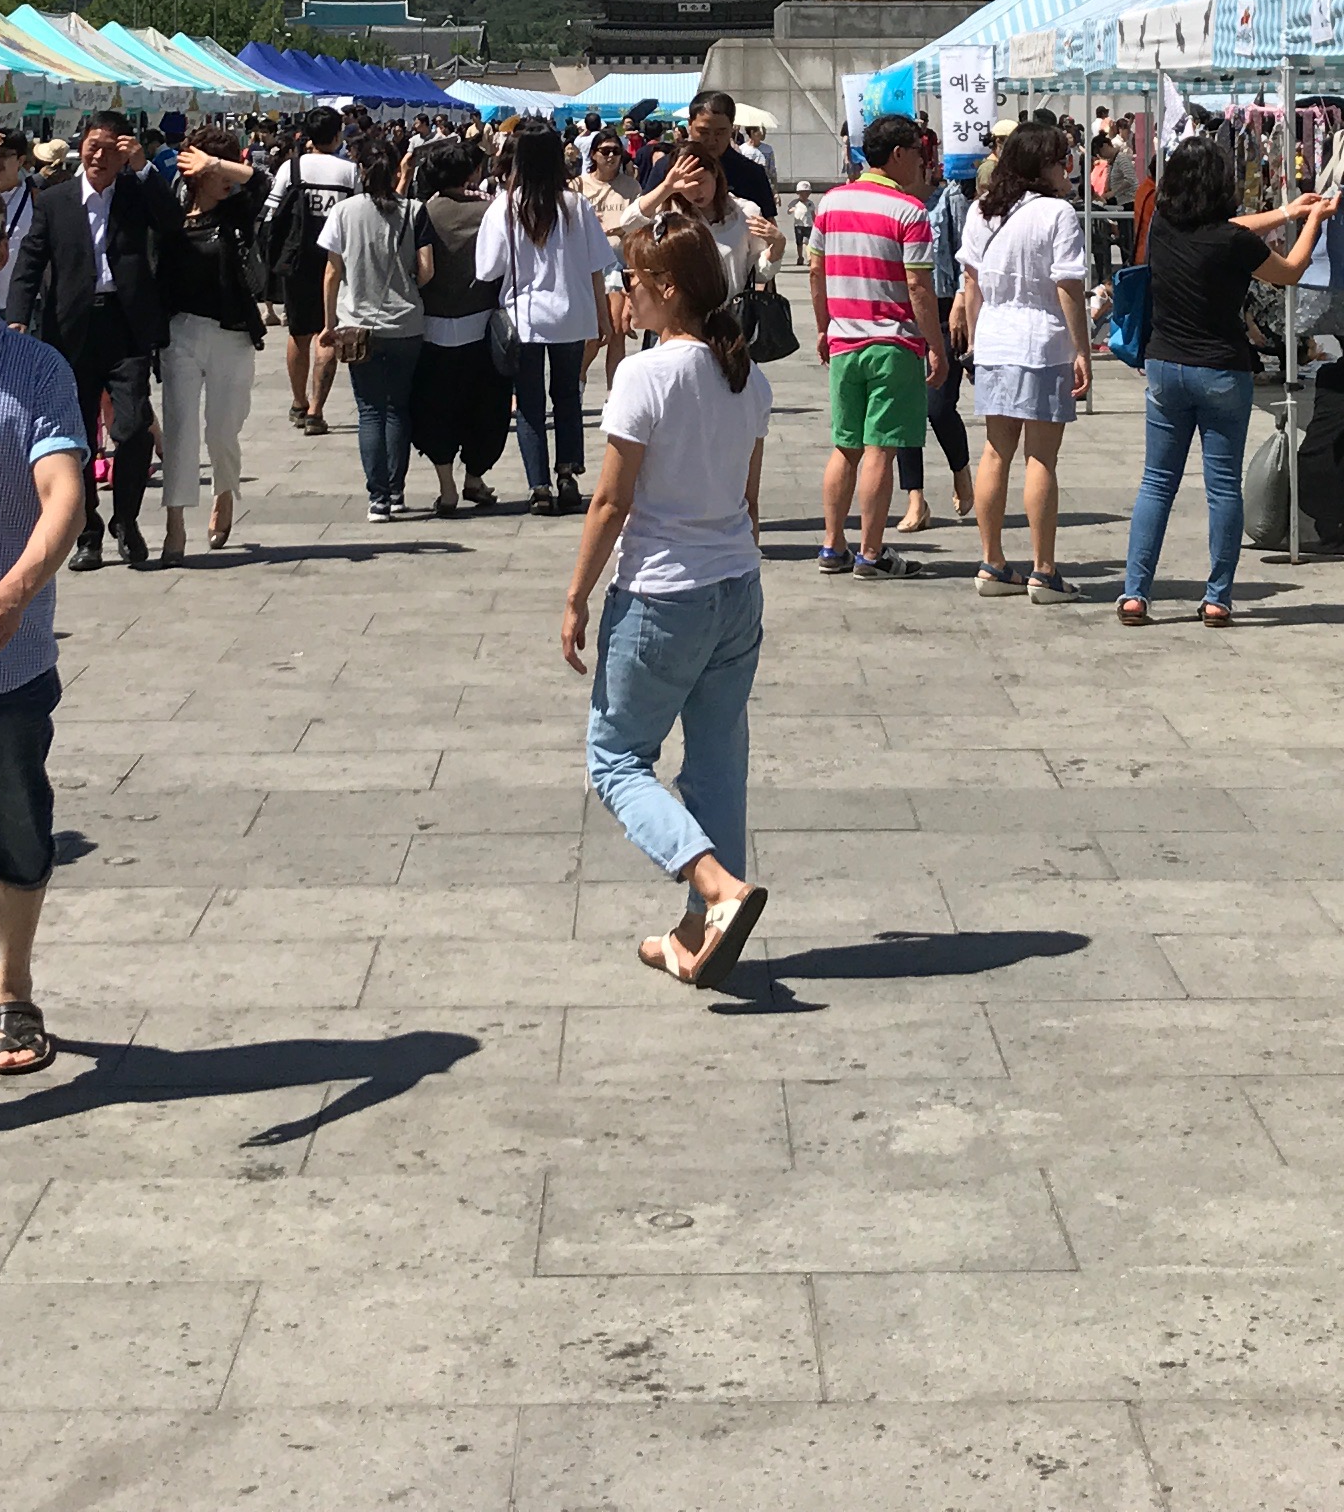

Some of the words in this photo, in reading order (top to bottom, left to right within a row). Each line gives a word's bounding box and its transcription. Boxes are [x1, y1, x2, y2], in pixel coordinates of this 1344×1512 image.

[949, 74, 990, 93] 예술
[963, 97, 979, 115] &
[952, 121, 991, 142] 창업
